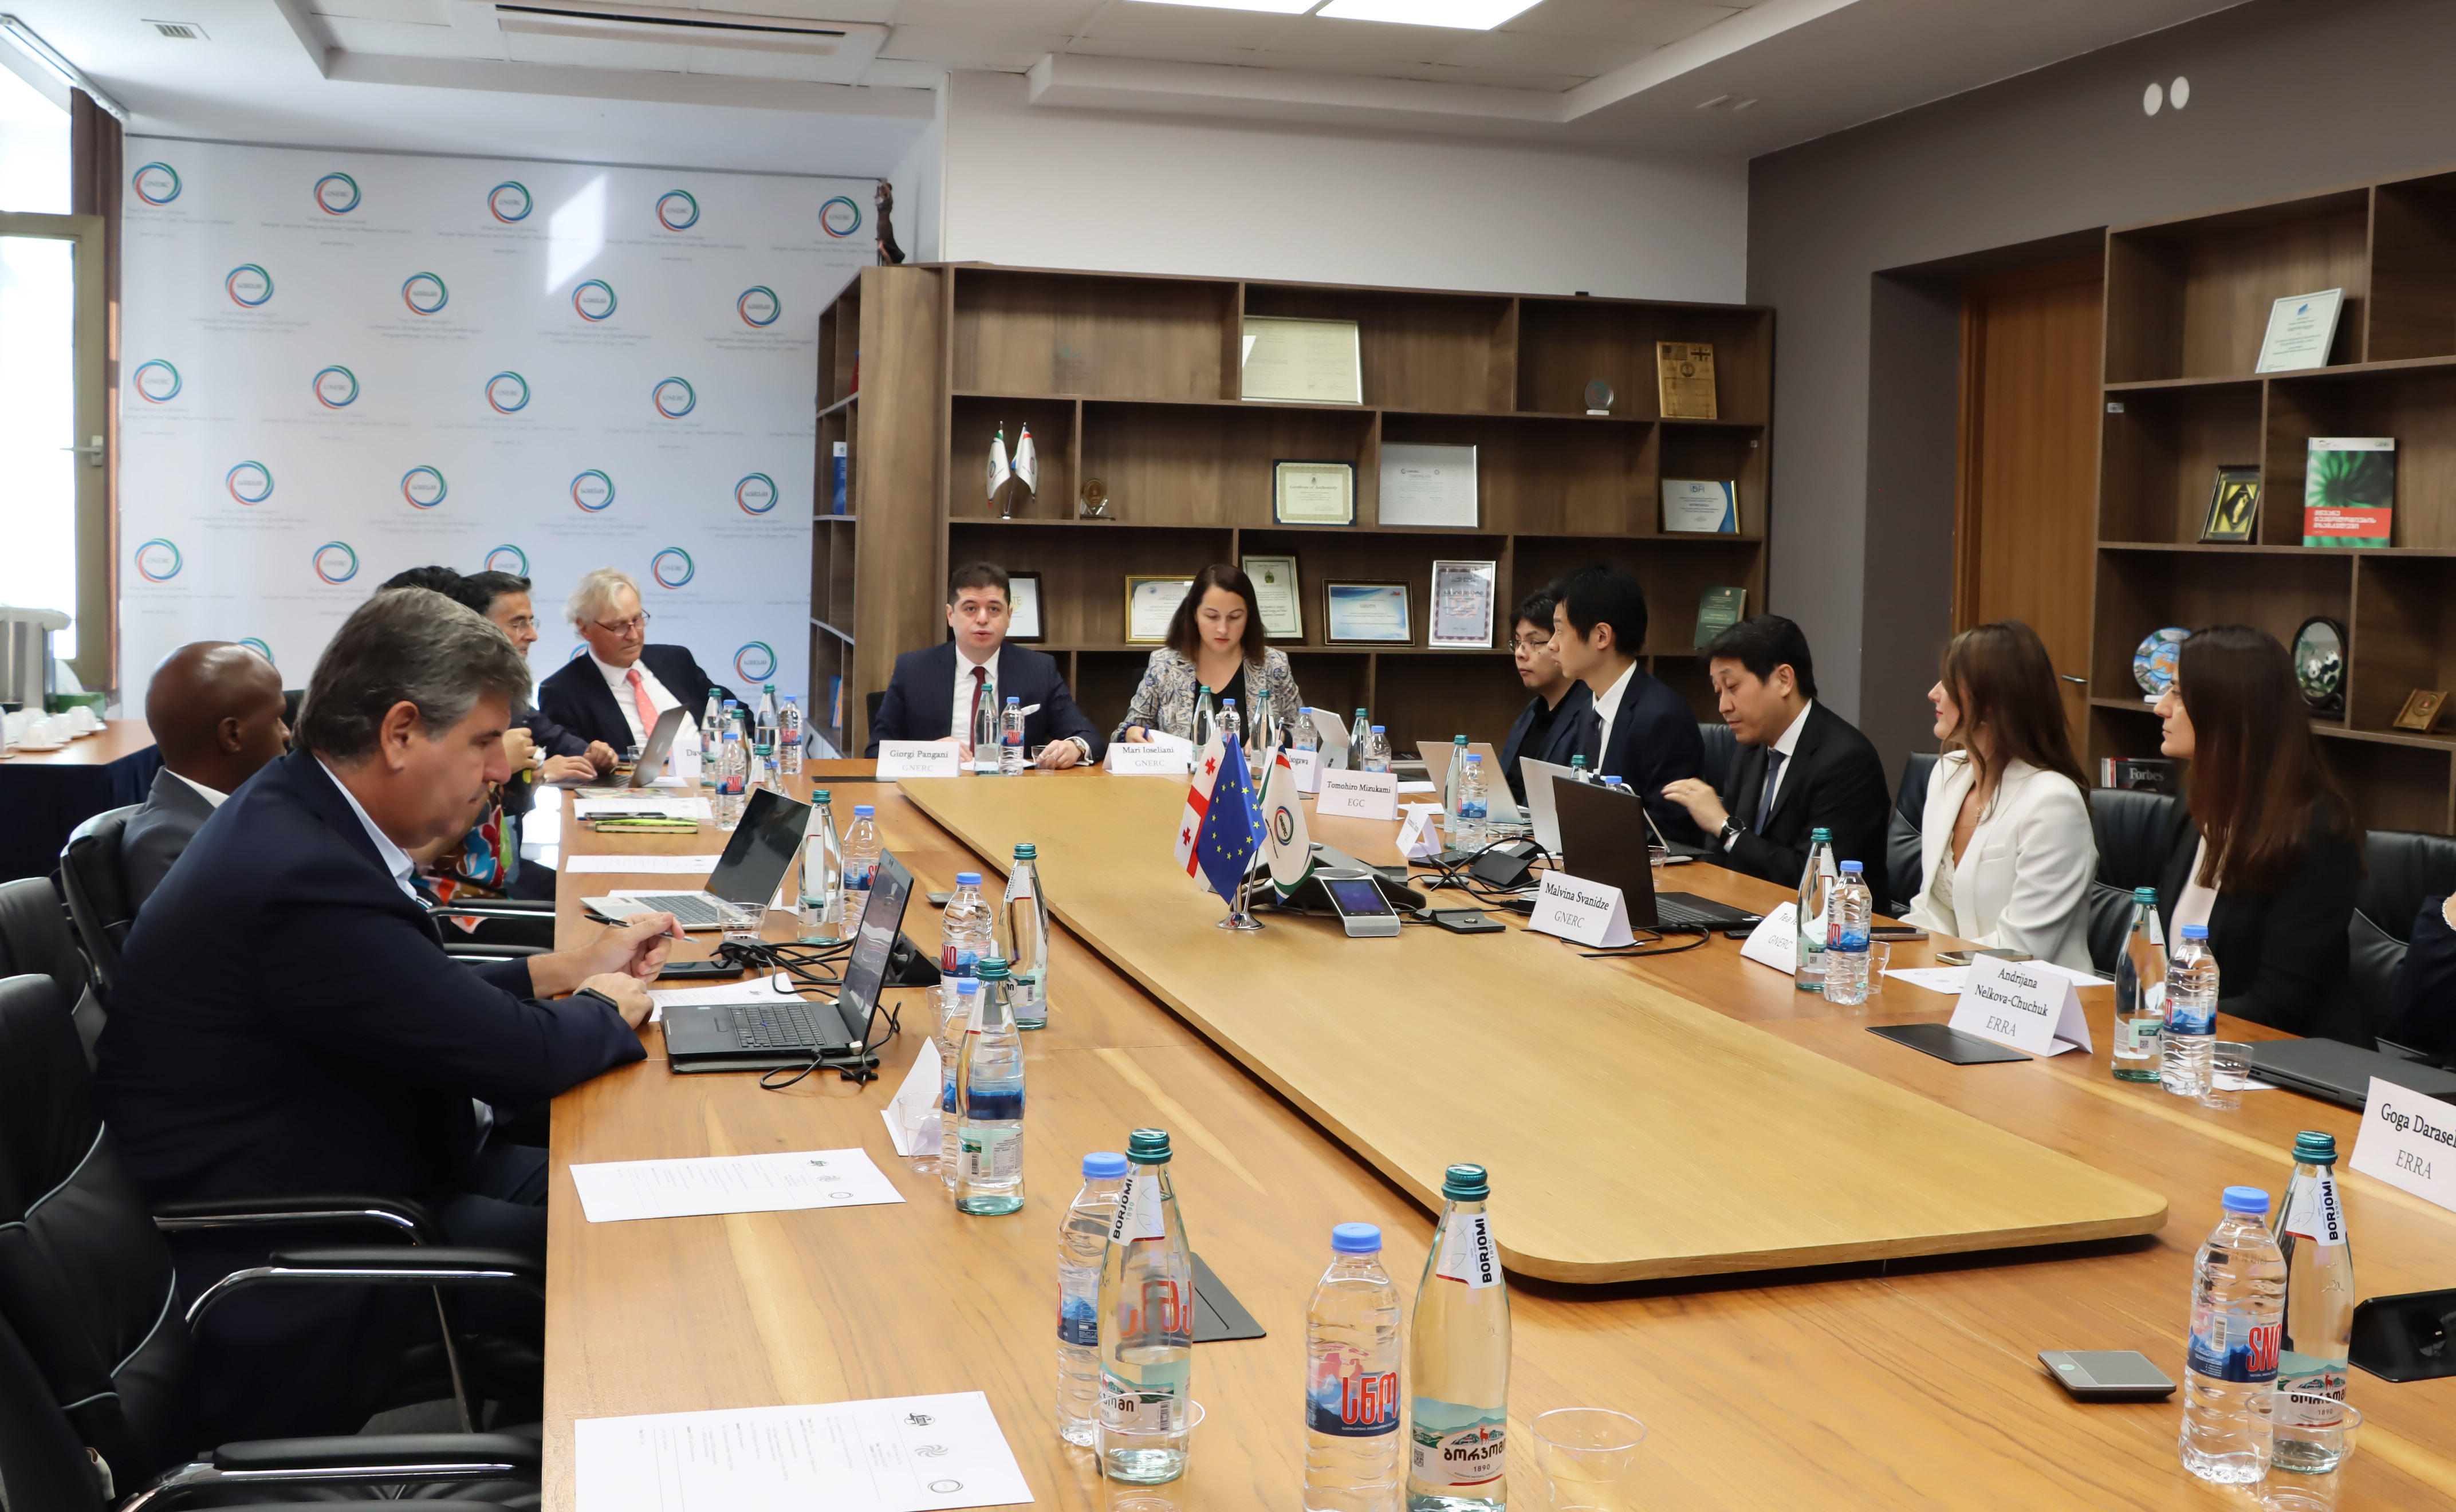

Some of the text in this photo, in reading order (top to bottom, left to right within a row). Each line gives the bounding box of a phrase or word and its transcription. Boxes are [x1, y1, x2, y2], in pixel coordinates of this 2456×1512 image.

[889, 750, 948, 761] Giorgi Pangani
[2129, 767, 2164, 781] Forbes
[1327, 781, 1391, 793] Tomohiro Mizukami
[1348, 798, 1365, 808] EGC
[1278, 815, 1288, 837] GNERC
[1545, 882, 1609, 911] Malvina Svanidze
[1554, 911, 1585, 928] GNERC
[1768, 935, 1793, 950] GNERC
[1997, 967, 2038, 989] Andrijana
[1974, 983, 2049, 1017] Nelkova-Chuchuk
[1986, 1015, 2017, 1037] ERRA
[2381, 1102, 2456, 1149] Goga Darasel
[2395, 1149, 2431, 1180] ERRA
[1113, 1178, 1133, 1239] BORJOMI
[2321, 1181, 2339, 1241] BORJOMI
[1475, 1218, 1492, 1283] BORJOMI
[2246, 1324, 2282, 1372] SNO
[1341, 1371, 1398, 1425] სნო
[1474, 1463, 1491, 1472] 1890
